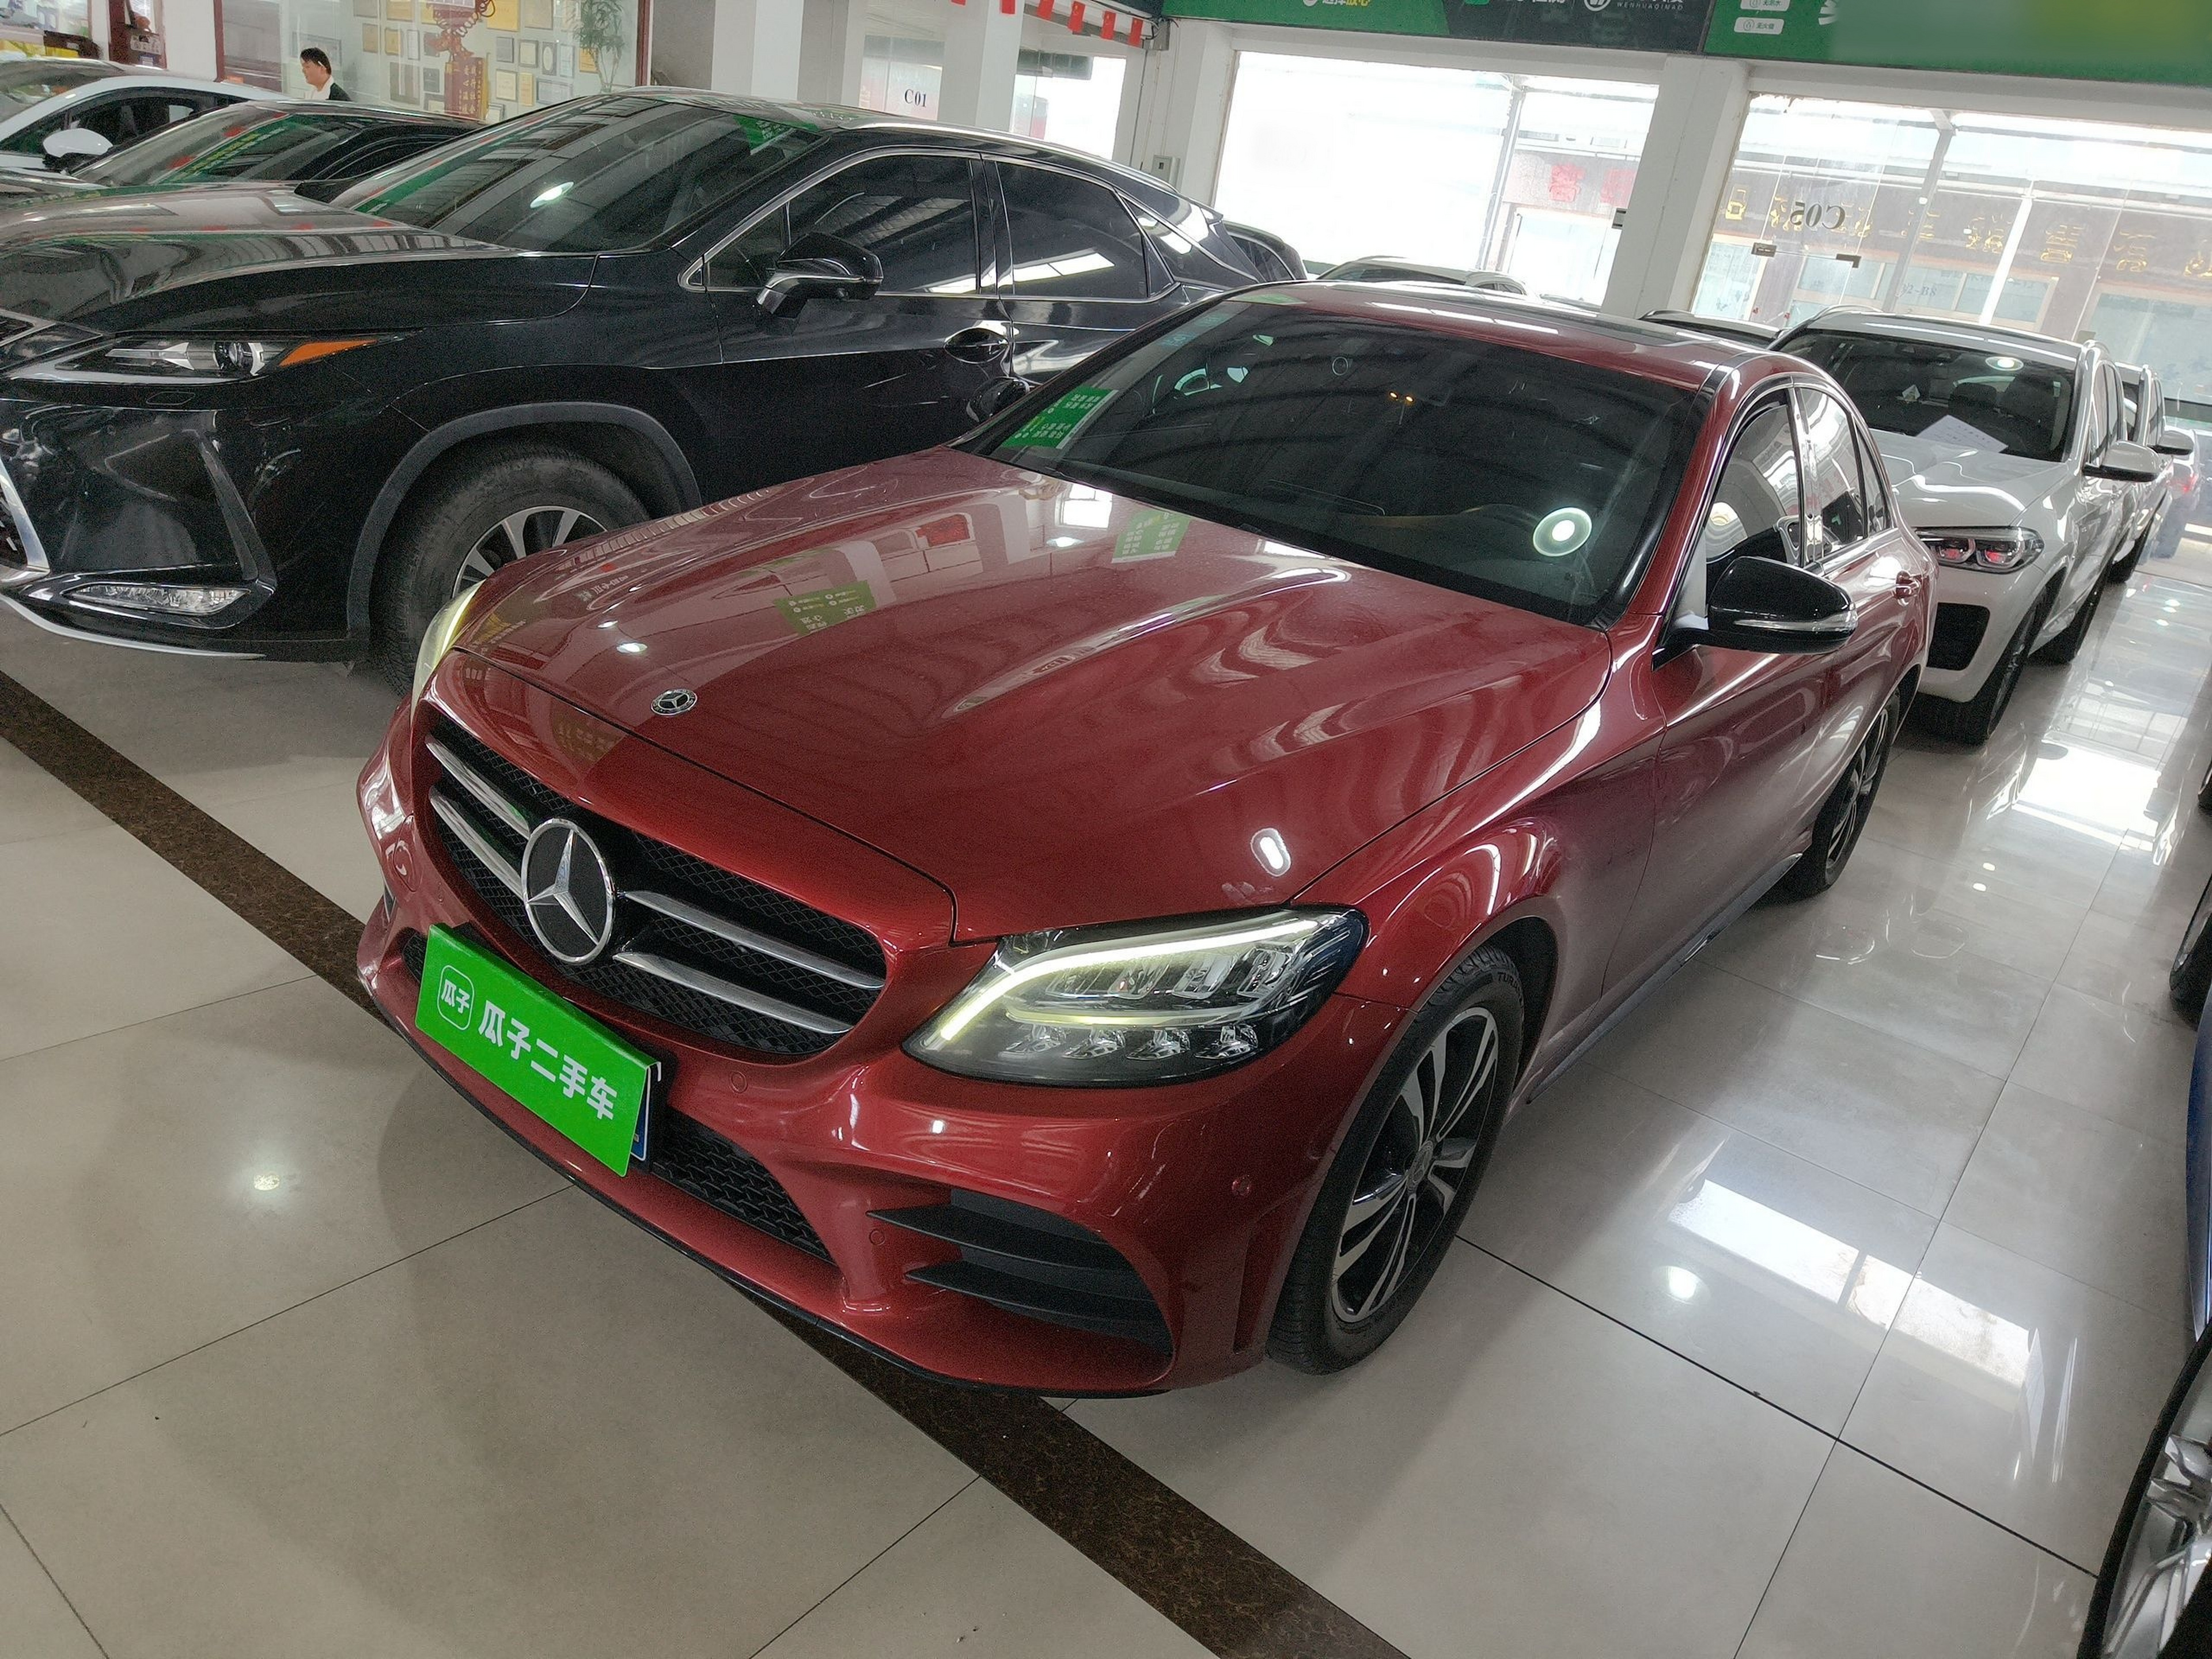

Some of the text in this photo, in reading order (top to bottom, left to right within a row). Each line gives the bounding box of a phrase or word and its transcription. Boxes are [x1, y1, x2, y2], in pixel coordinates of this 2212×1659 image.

[904, 89, 926, 108] C01
[441, 979, 471, 1014] 瓜子
[478, 1000, 618, 1120] 瓜子二手车
